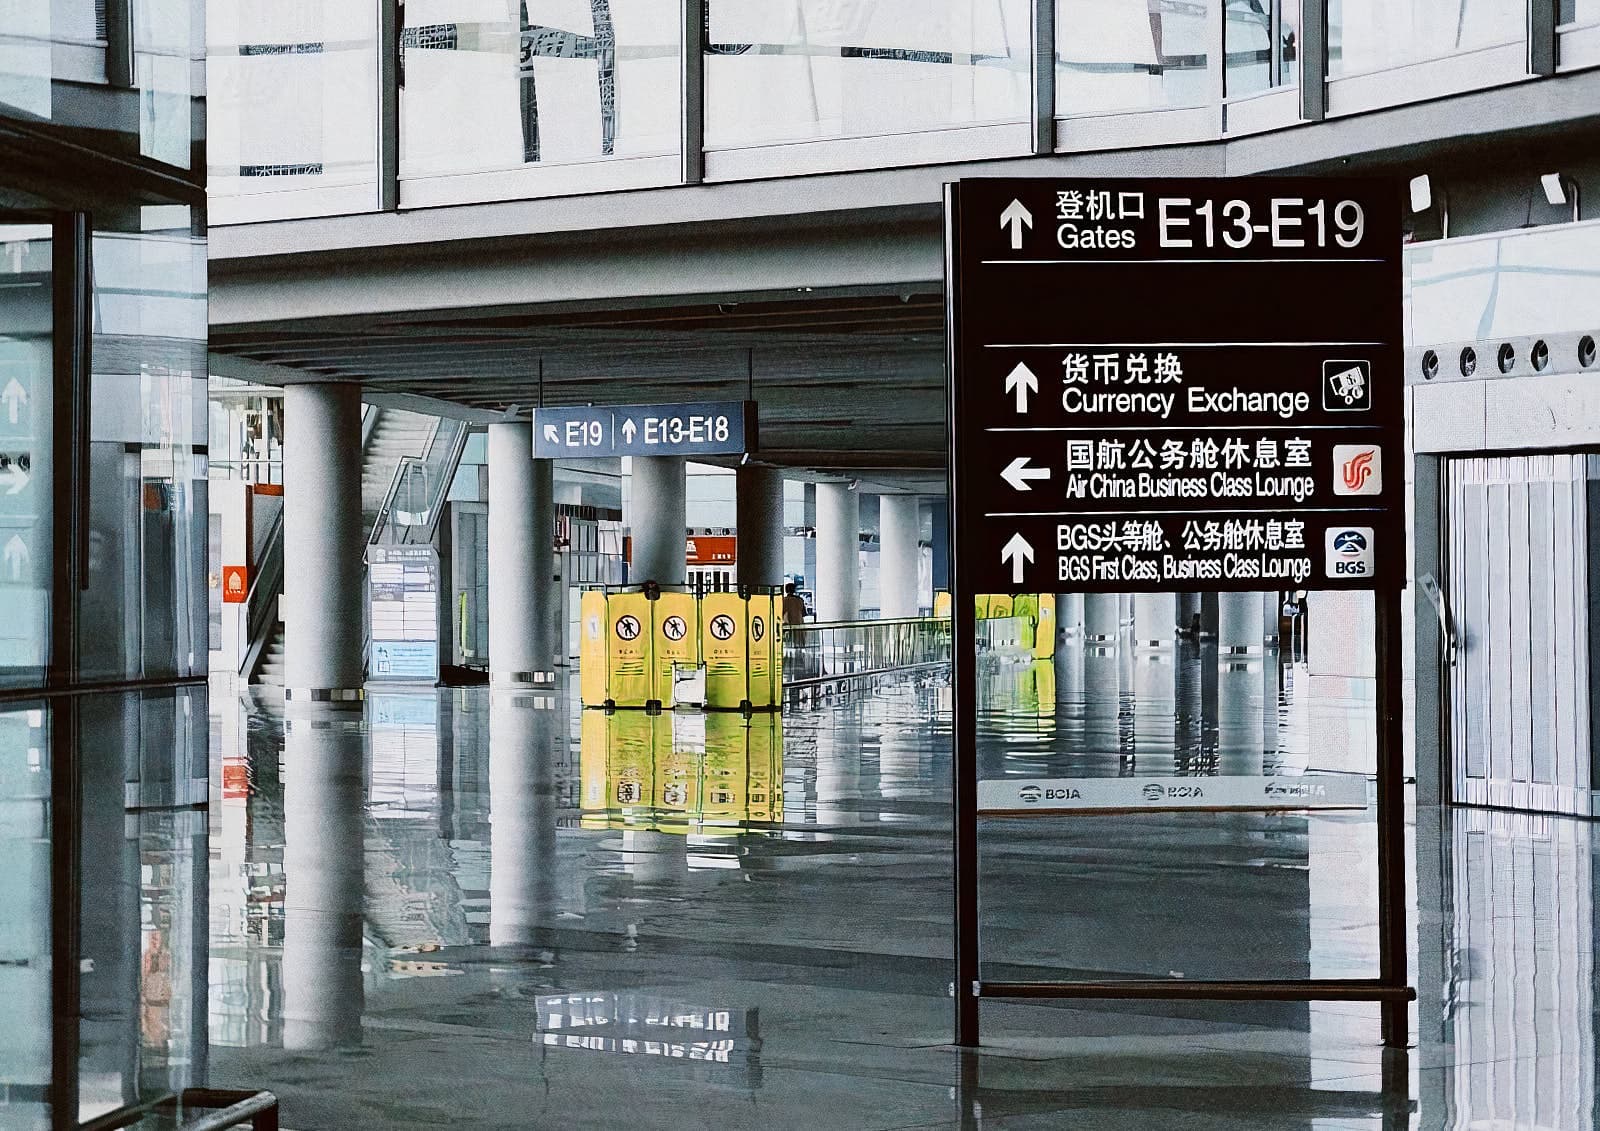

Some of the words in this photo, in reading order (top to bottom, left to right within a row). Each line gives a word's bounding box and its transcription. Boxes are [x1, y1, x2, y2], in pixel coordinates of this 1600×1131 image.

[1056, 190, 1144, 221] 登机口
[1056, 223, 1136, 249] Gates
[1158, 197, 1364, 249] E13-E19
[1061, 353, 1183, 385] 货币兑换
[1062, 387, 1175, 418] Currency
[1188, 387, 1310, 418] Exchange
[565, 421, 603, 447] E19
[644, 415, 729, 444] E13-E18
[1066, 437, 1312, 471] 国航公务舱休息室
[1066, 474, 1088, 498] Air
[1090, 473, 1136, 498] China
[1138, 473, 1207, 497] Business
[1210, 472, 1252, 497] Class
[1255, 472, 1315, 502] Lounge
[1058, 556, 1091, 581] BGS
[1092, 556, 1119, 579] First
[1121, 555, 1161, 582] Class,
[1163, 554, 1222, 579] Business
[1223, 553, 1259, 578] Class
[1261, 553, 1312, 583] Lounge
[1335, 561, 1366, 575] BGS
